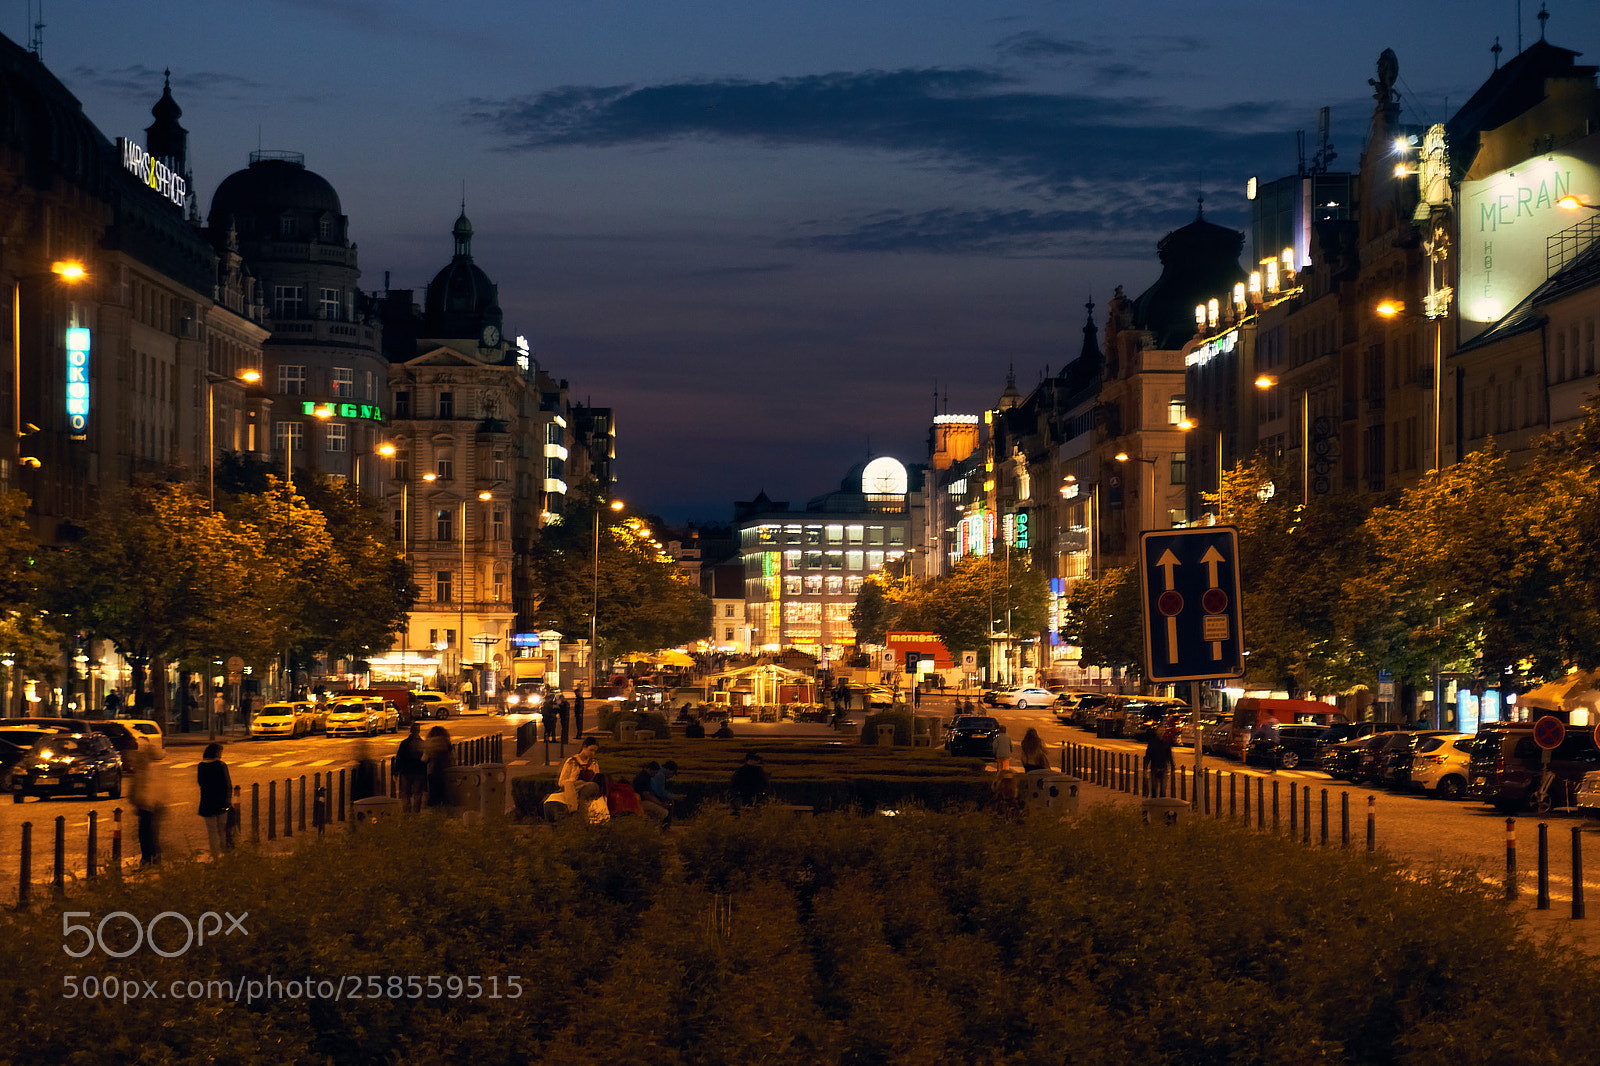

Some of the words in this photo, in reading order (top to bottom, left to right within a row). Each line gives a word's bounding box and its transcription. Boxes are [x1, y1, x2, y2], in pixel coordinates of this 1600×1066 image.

[1480, 171, 1571, 232] MERAN
[1484, 241, 1493, 302] HOTE
[1016, 513, 1028, 549] GATE
[909, 654, 918, 667] P
